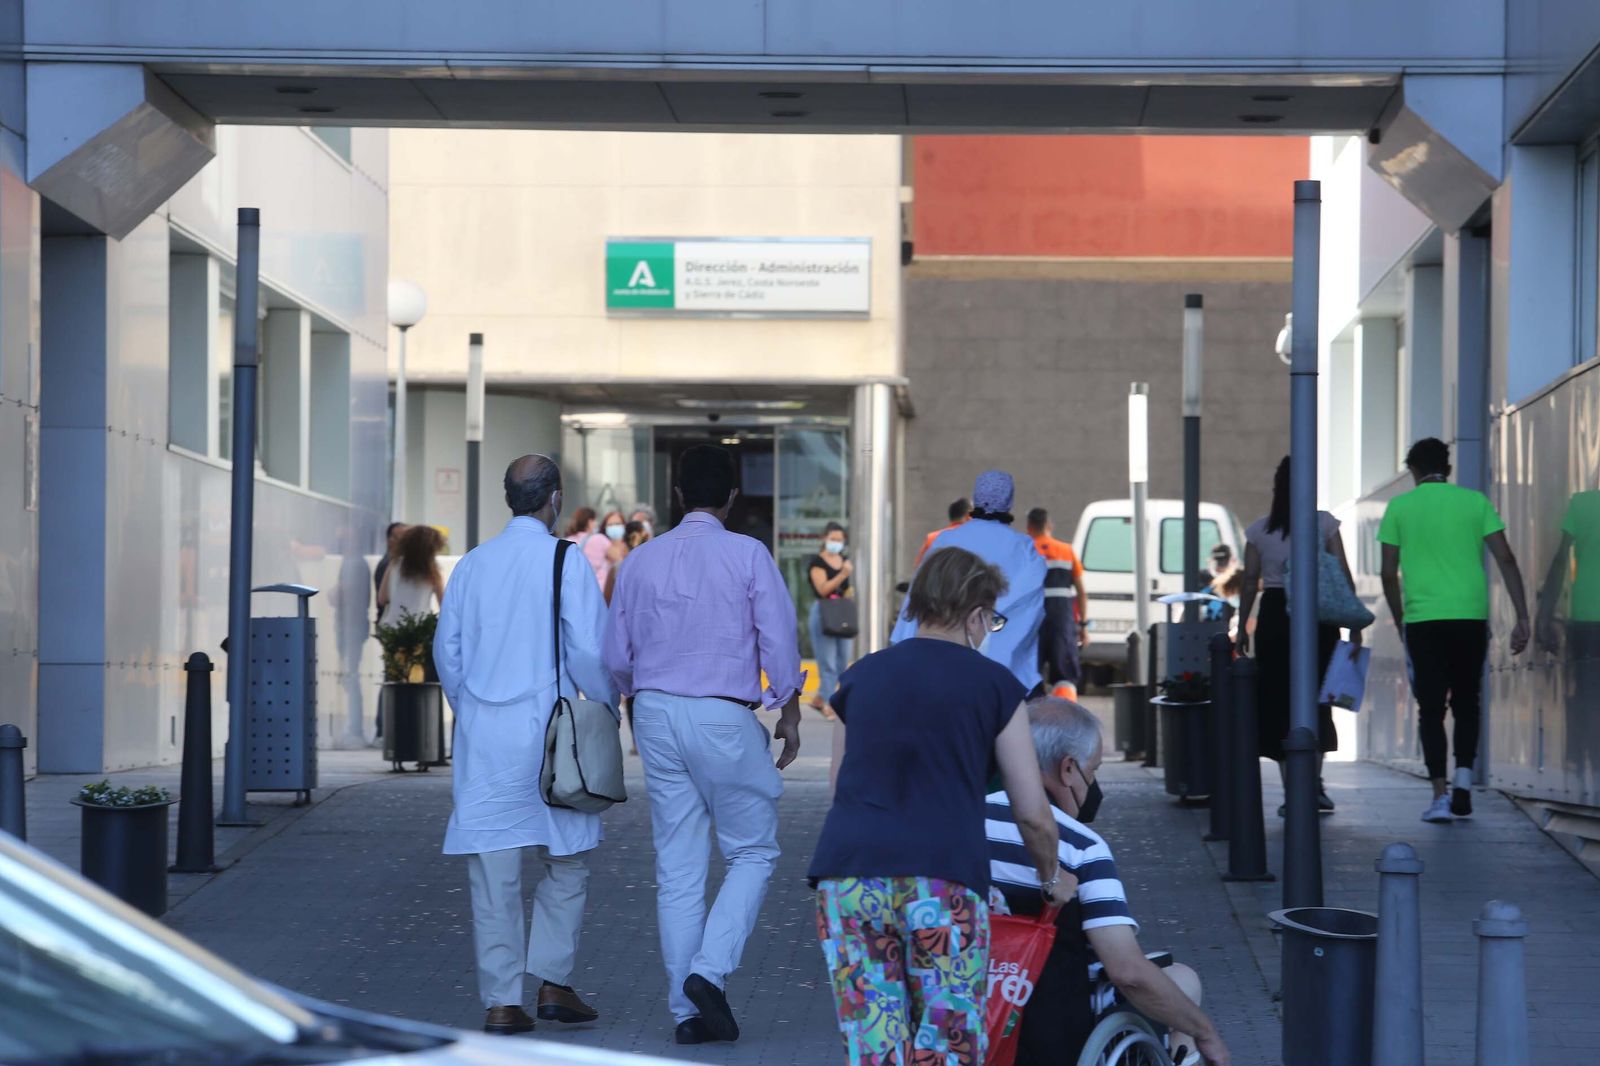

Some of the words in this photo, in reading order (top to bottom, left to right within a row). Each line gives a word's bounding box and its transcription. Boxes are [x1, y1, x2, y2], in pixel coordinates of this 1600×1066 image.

[628, 260, 656, 288] A
[685, 260, 748, 273] Dirección
[758, 260, 860, 274] Administración
[988, 959, 1019, 974] Las
